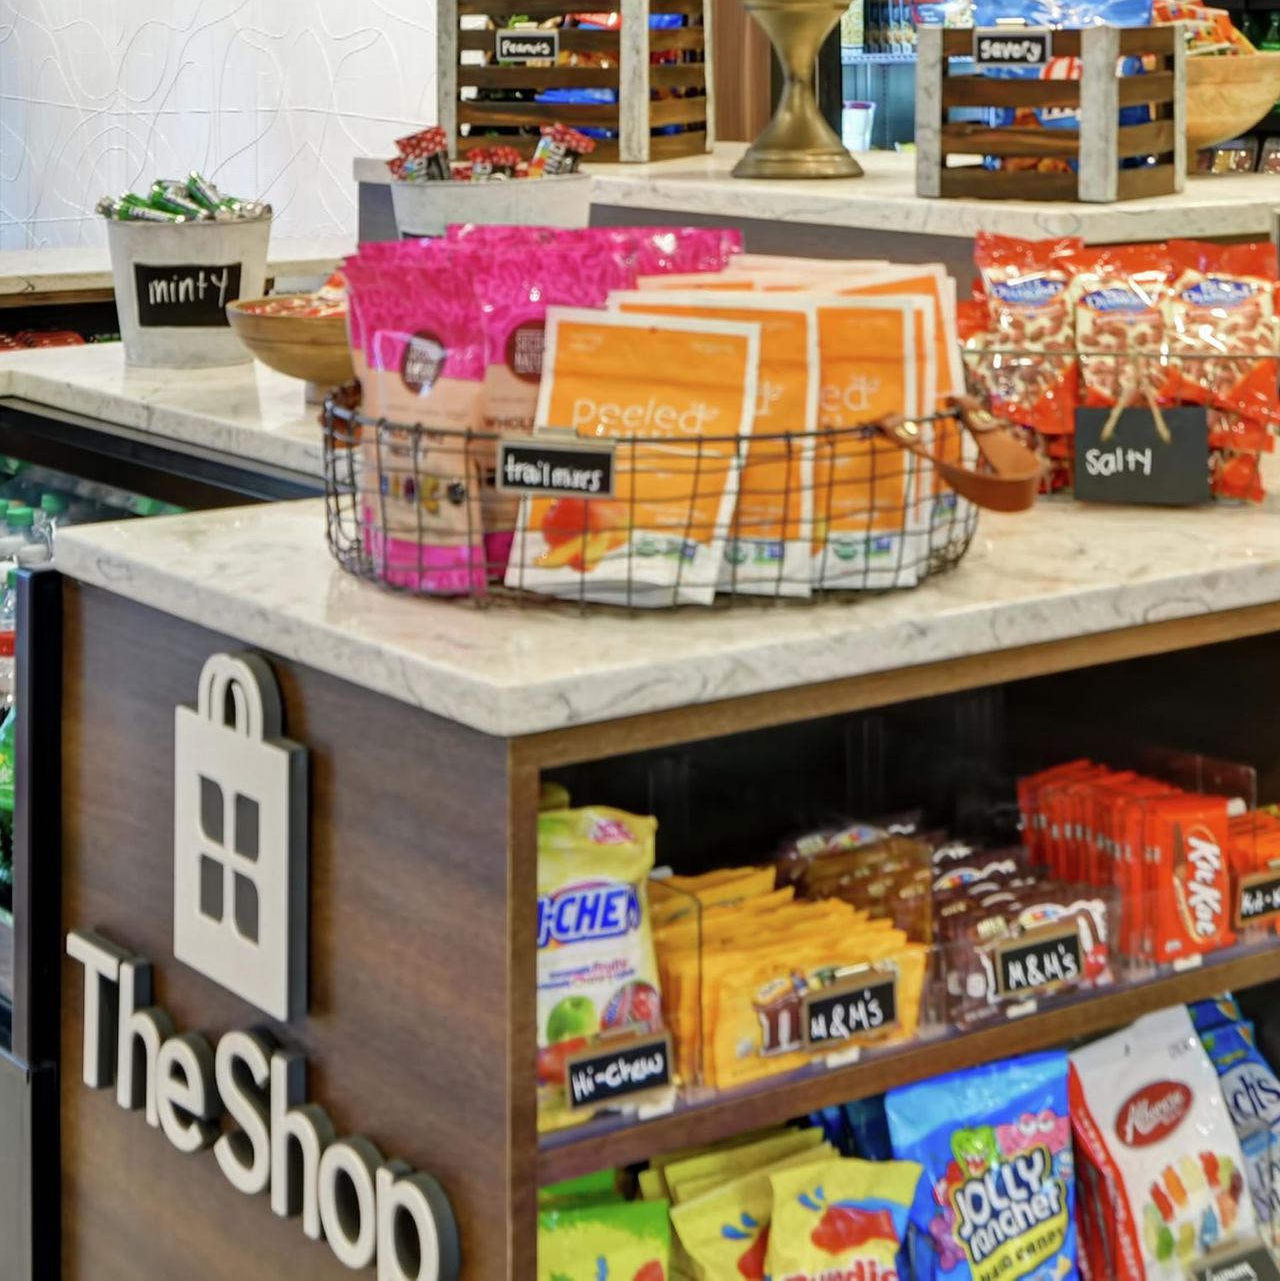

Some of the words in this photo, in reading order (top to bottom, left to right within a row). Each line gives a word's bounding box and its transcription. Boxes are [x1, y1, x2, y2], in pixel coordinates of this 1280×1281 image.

[979, 38, 1043, 63] Savory
[148, 268, 230, 308] minty
[571, 396, 705, 434] peeled
[1084, 446, 1153, 477] Salty
[809, 990, 884, 1041] M&M's
[571, 1050, 666, 1102] Hi-Chew
[955, 1147, 1046, 1239] JOLLY
